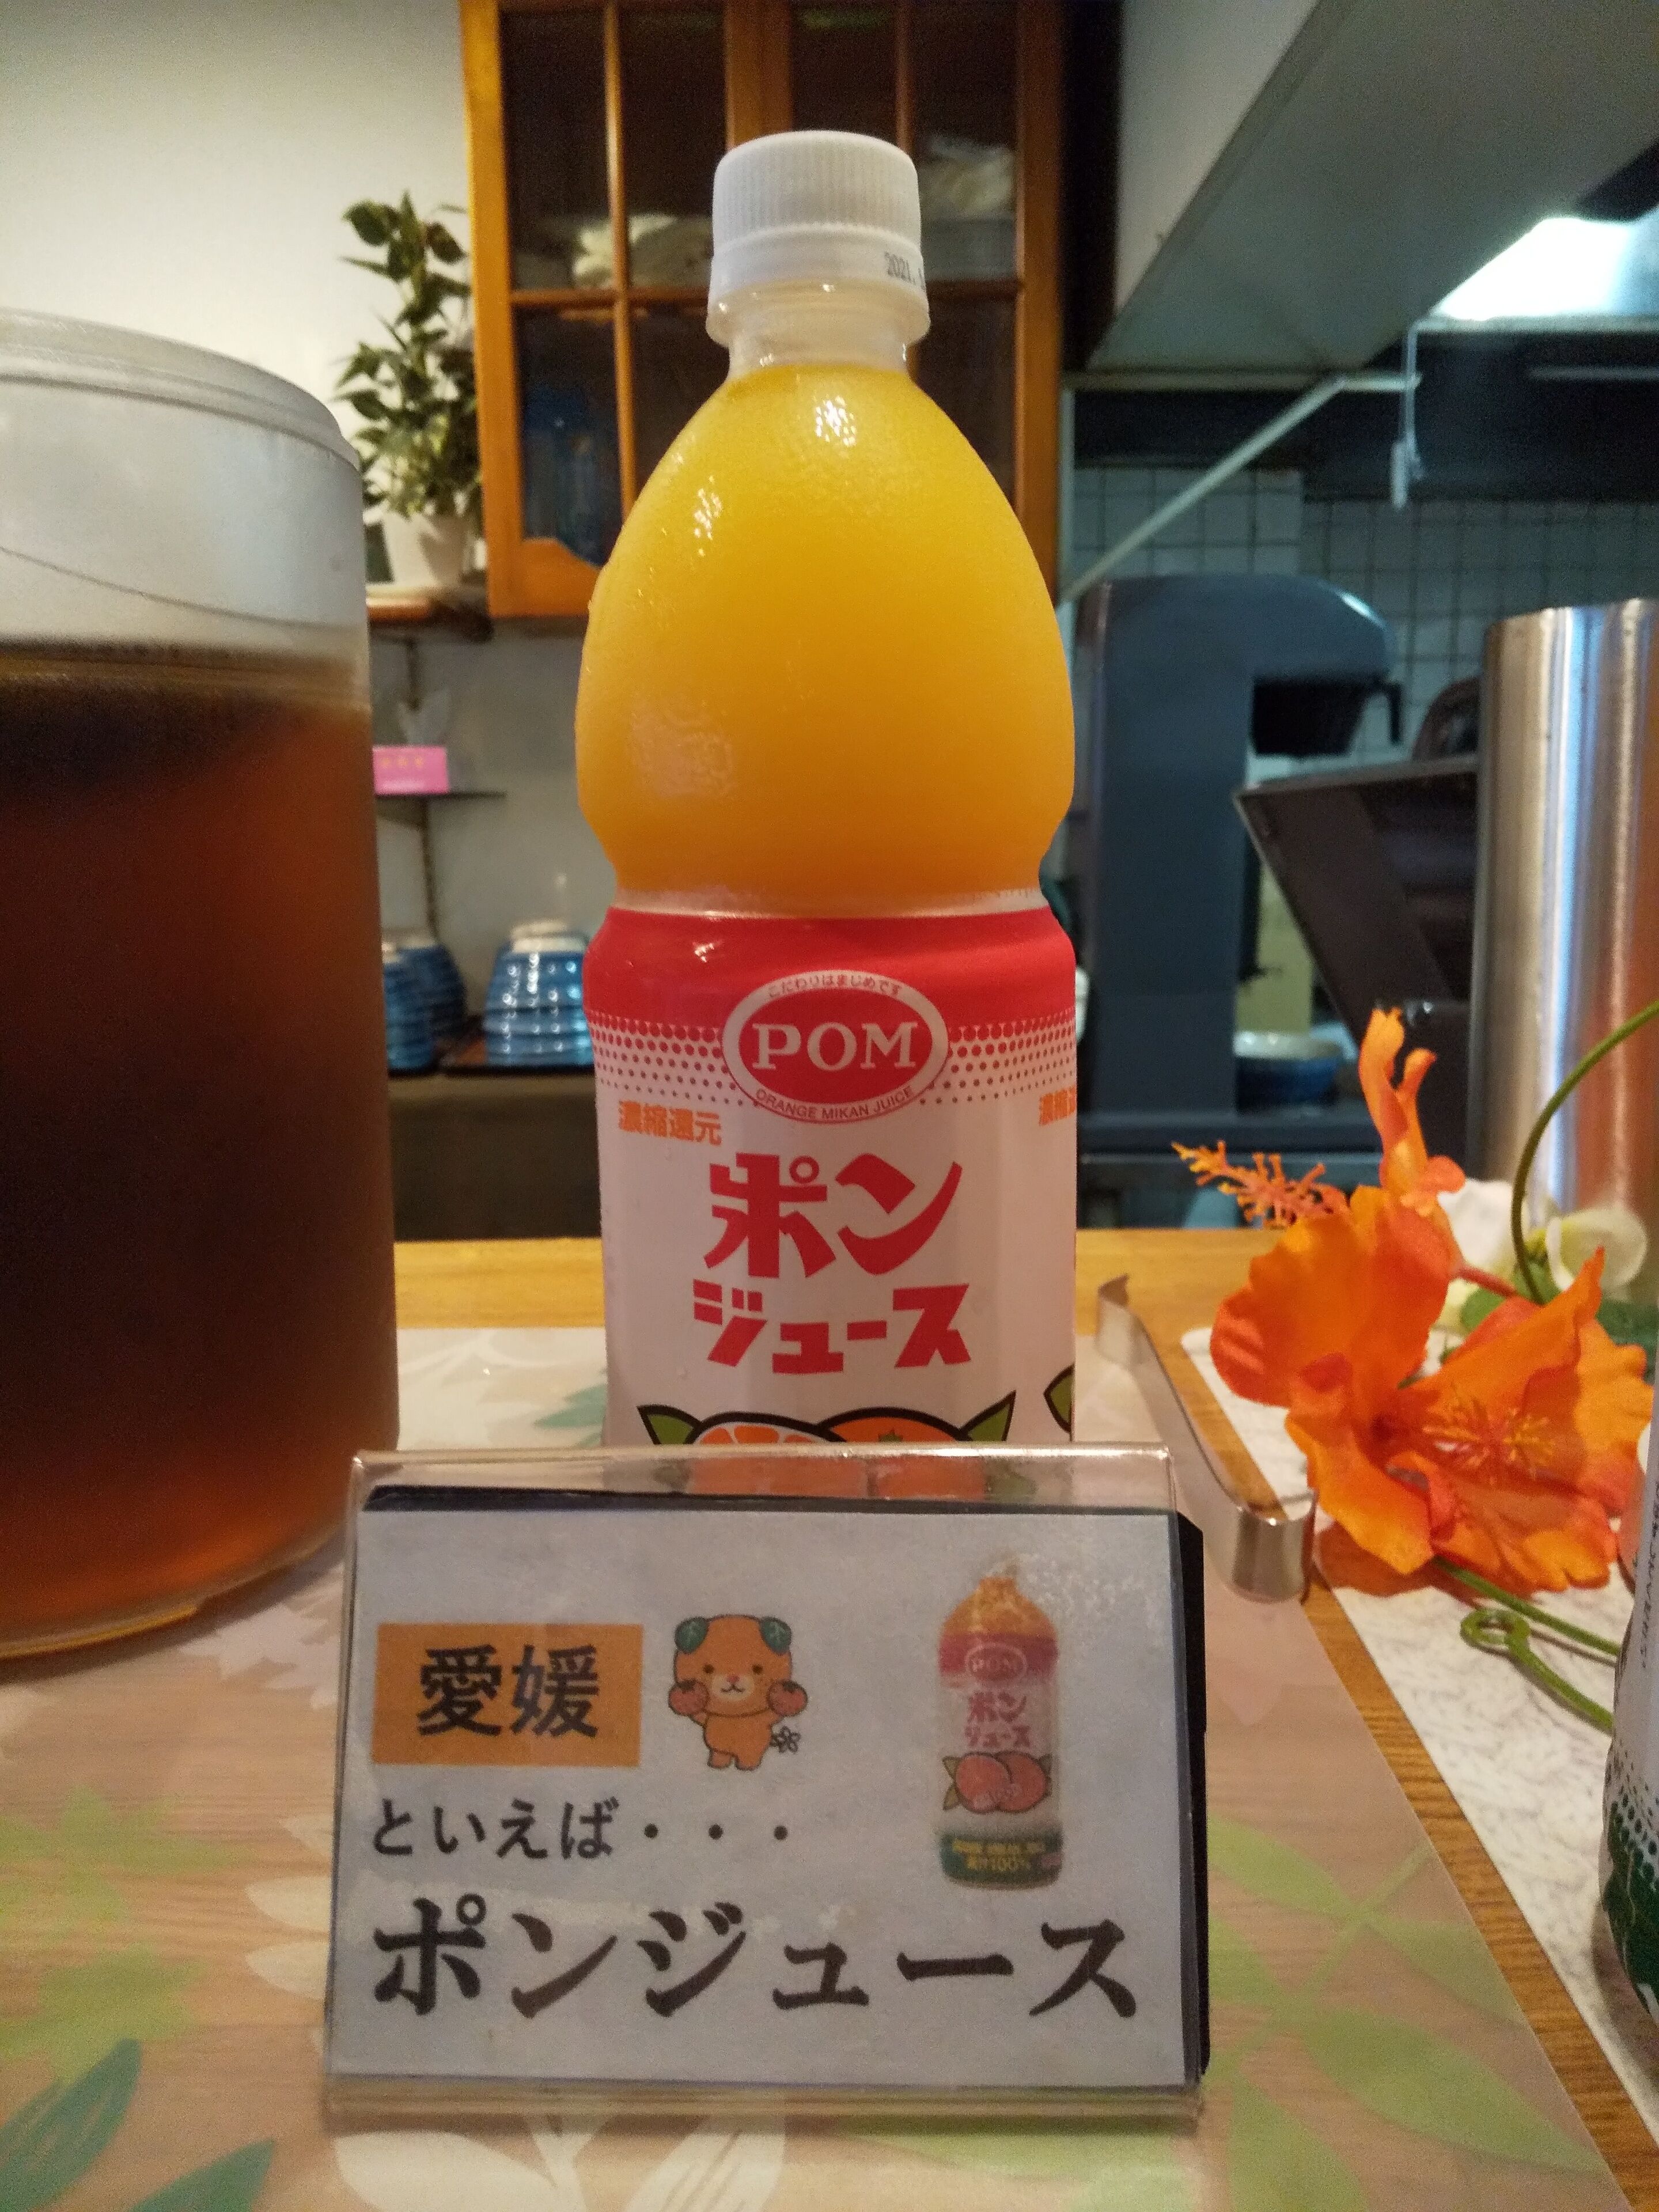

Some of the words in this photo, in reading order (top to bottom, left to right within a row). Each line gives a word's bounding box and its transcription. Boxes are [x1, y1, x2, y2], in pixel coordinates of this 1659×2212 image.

[752, 1022, 918, 1071] POM
[755, 1088, 817, 1119] ORANGE
[821, 1103, 869, 1119] MIKAN
[869, 1086, 913, 1113] JUICE
[703, 1153, 963, 1278] ポン
[692, 1278, 972, 1374] ジュース
[416, 1644, 600, 1738] 愛媛
[373, 1892, 1137, 2018] ポンジュース
